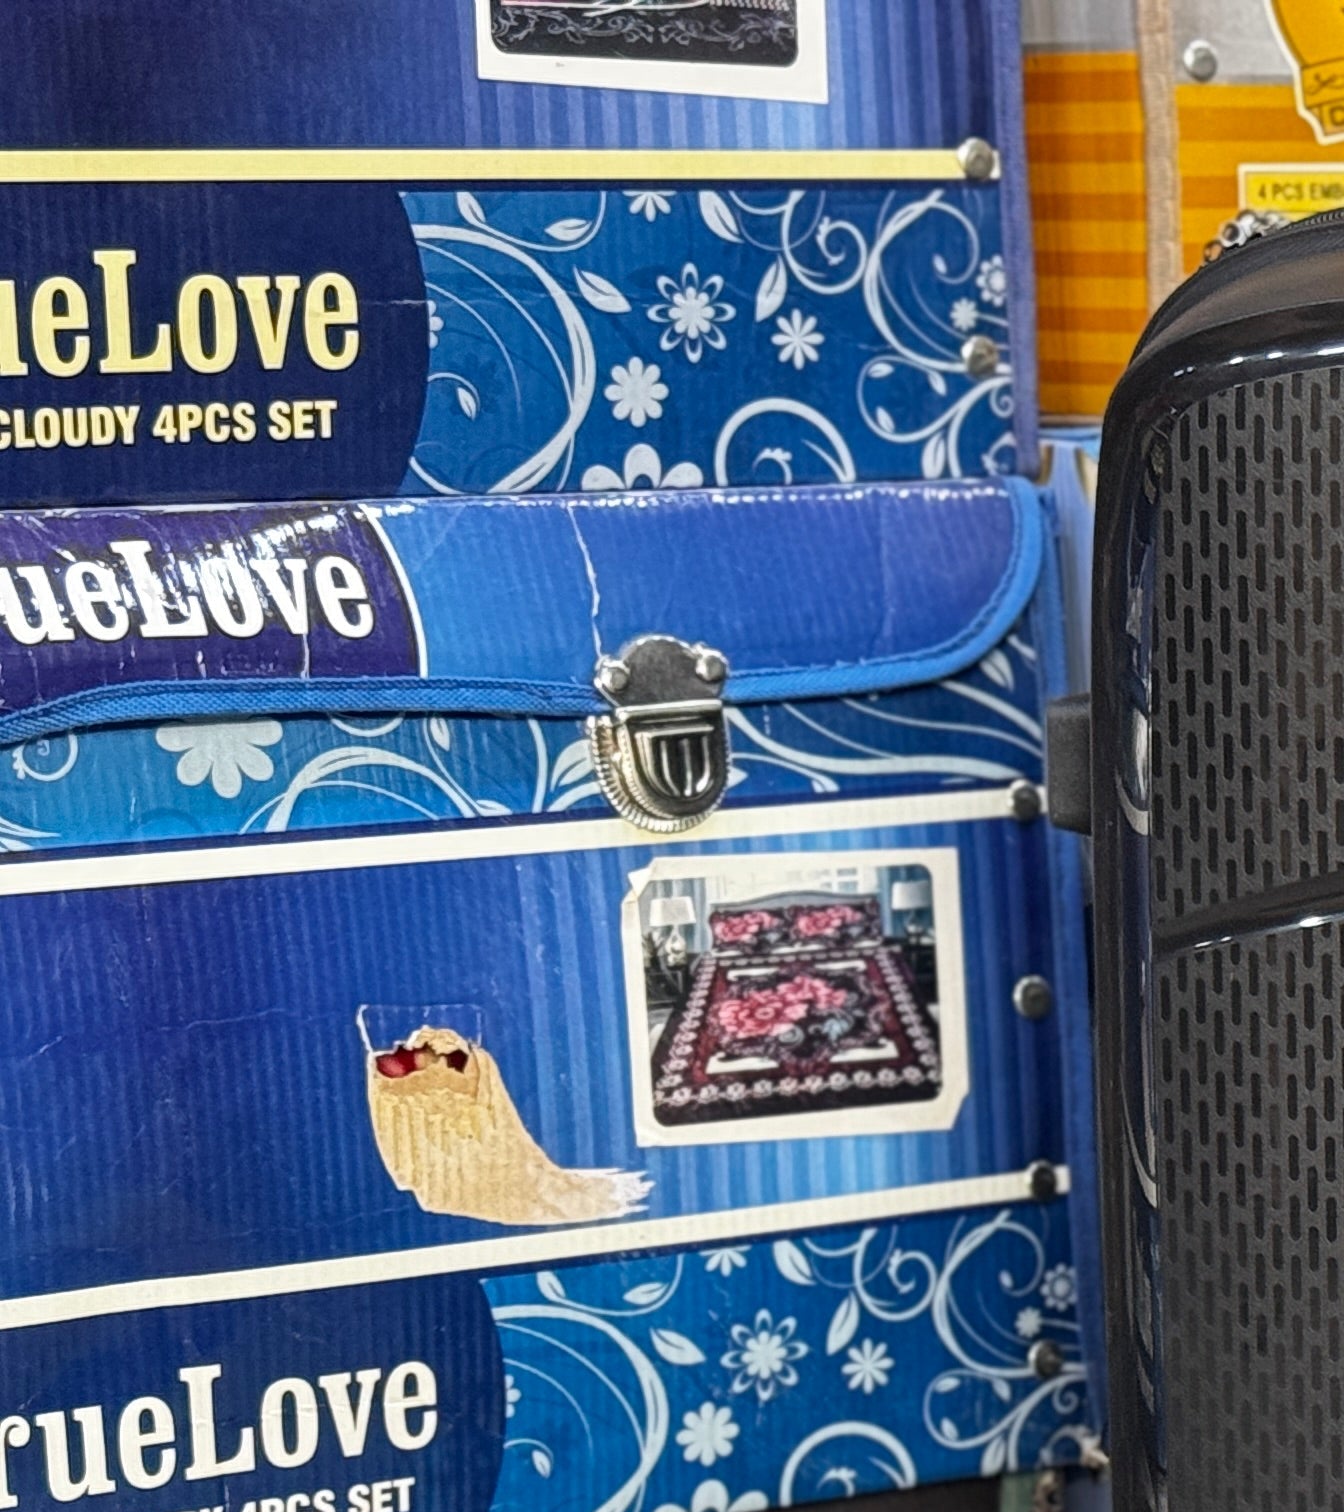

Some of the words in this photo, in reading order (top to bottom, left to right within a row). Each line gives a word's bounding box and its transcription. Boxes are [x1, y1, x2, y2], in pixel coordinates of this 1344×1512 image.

[1257, 182, 1268, 201] 4
[1272, 182, 1305, 202] PCS
[153, 402, 257, 444] 4PCS
[268, 400, 338, 442] SET
